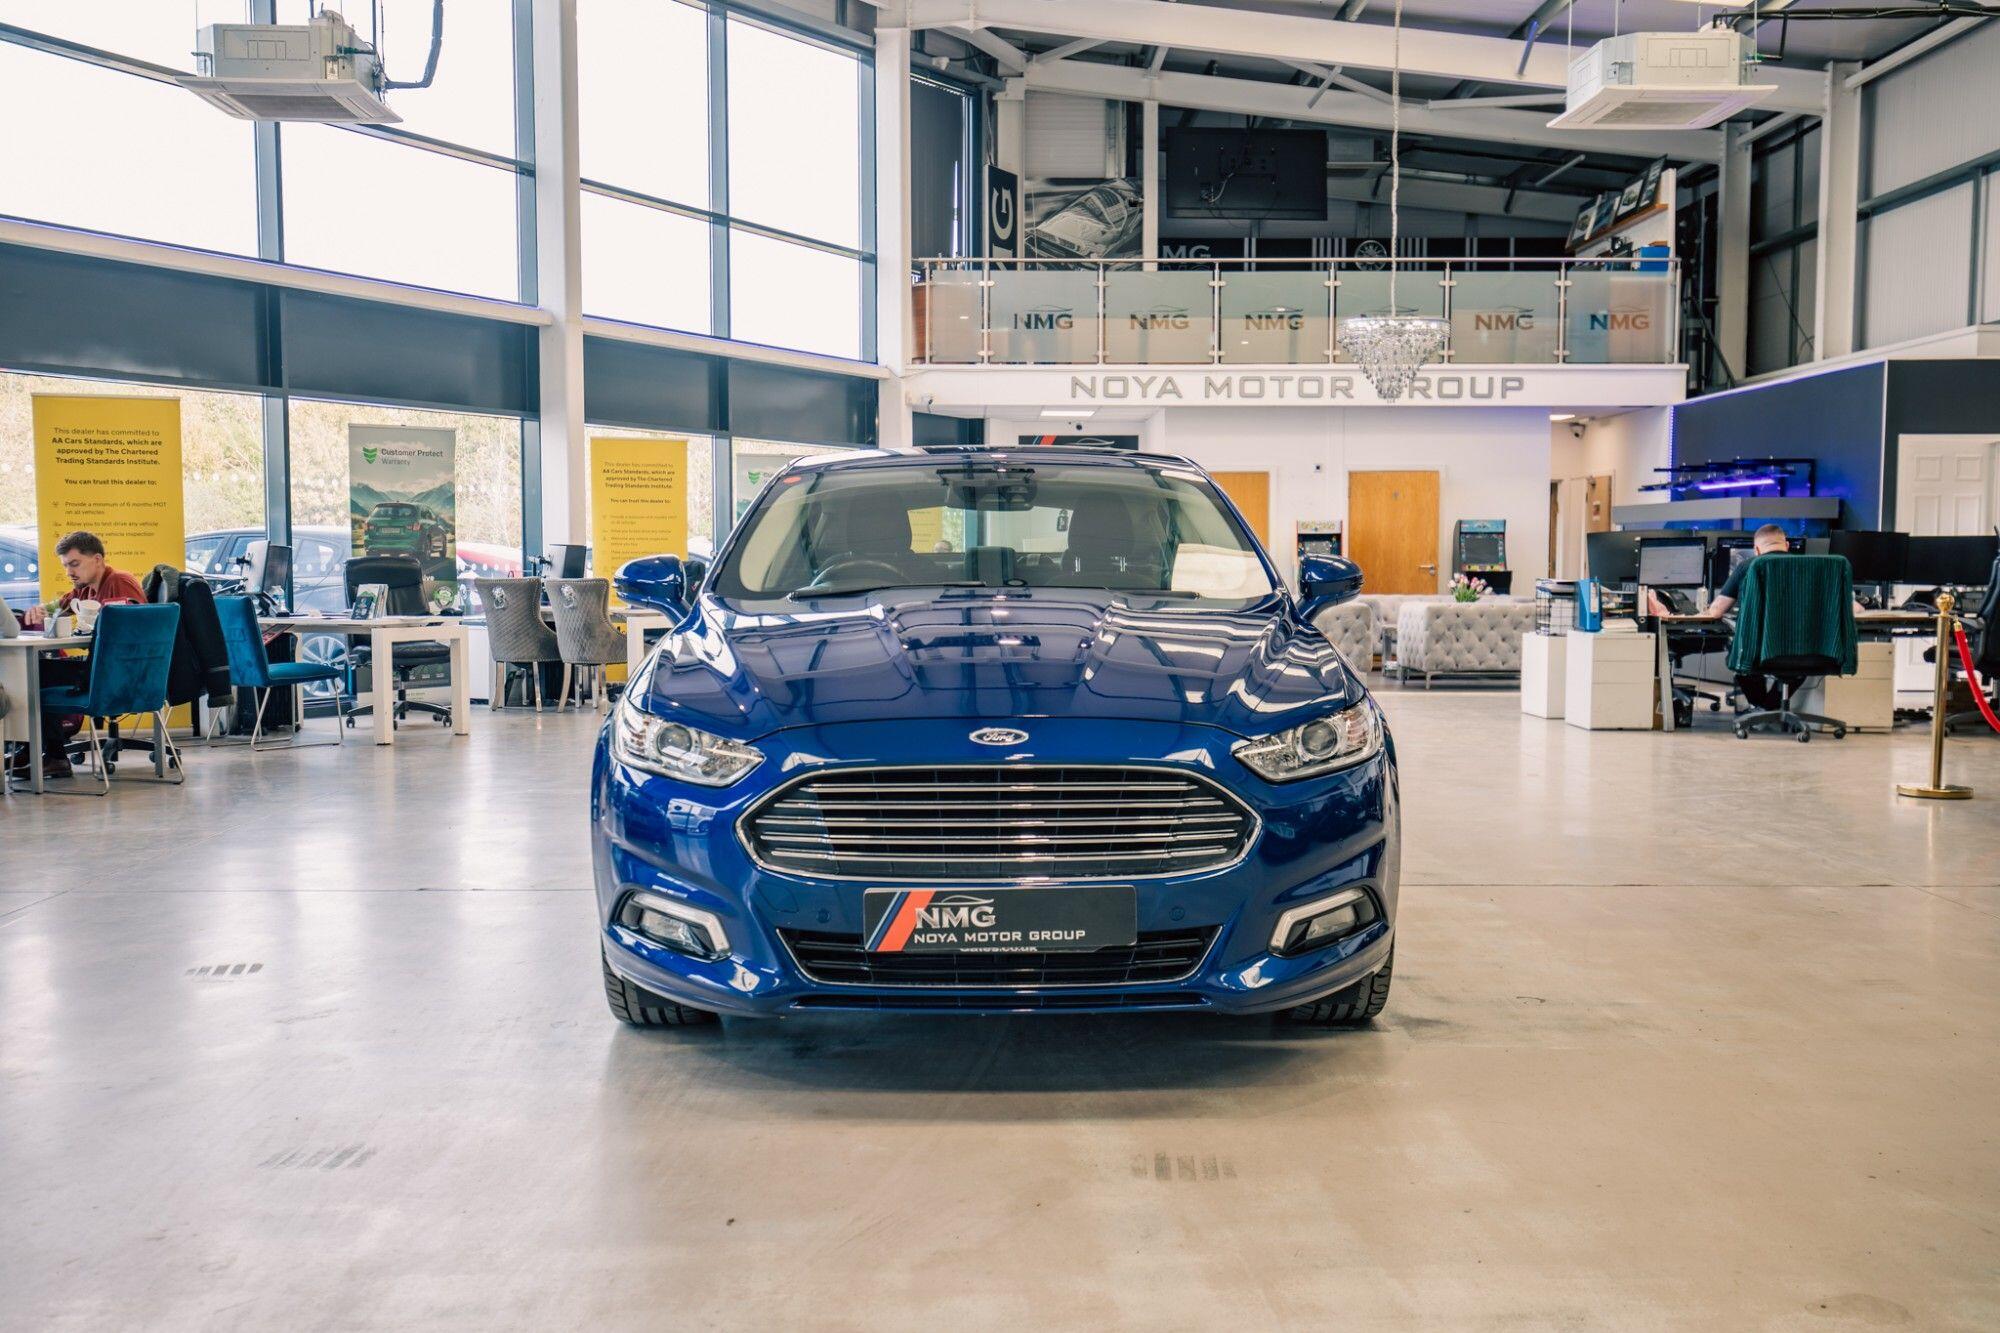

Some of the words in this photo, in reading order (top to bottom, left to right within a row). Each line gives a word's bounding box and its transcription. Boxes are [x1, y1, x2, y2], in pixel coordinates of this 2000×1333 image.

[1162, 245, 1211, 262] MG
[1014, 313, 1073, 330] NMG
[1130, 313, 1189, 330] NMG
[1245, 314, 1304, 330] NMG
[1475, 314, 1534, 330] NMG
[1590, 314, 1649, 330] NMG
[1071, 376, 1183, 399] NOYA
[1204, 376, 1354, 399] MOTOR
[1377, 376, 1525, 399] ROUP
[64, 437, 83, 445] Cars
[84, 438, 125, 446] Standards,
[95, 448, 104, 456] by
[121, 448, 158, 456] Chartered
[381, 448, 416, 456] Customer
[417, 449, 443, 457] Protect
[56, 457, 84, 465] Trading
[86, 457, 125, 465] Standards
[914, 906, 996, 929] NMG
[914, 932, 957, 944] NOYA
[964, 931, 1022, 943] MOTOR
[1029, 930, 1085, 941] GROUP
